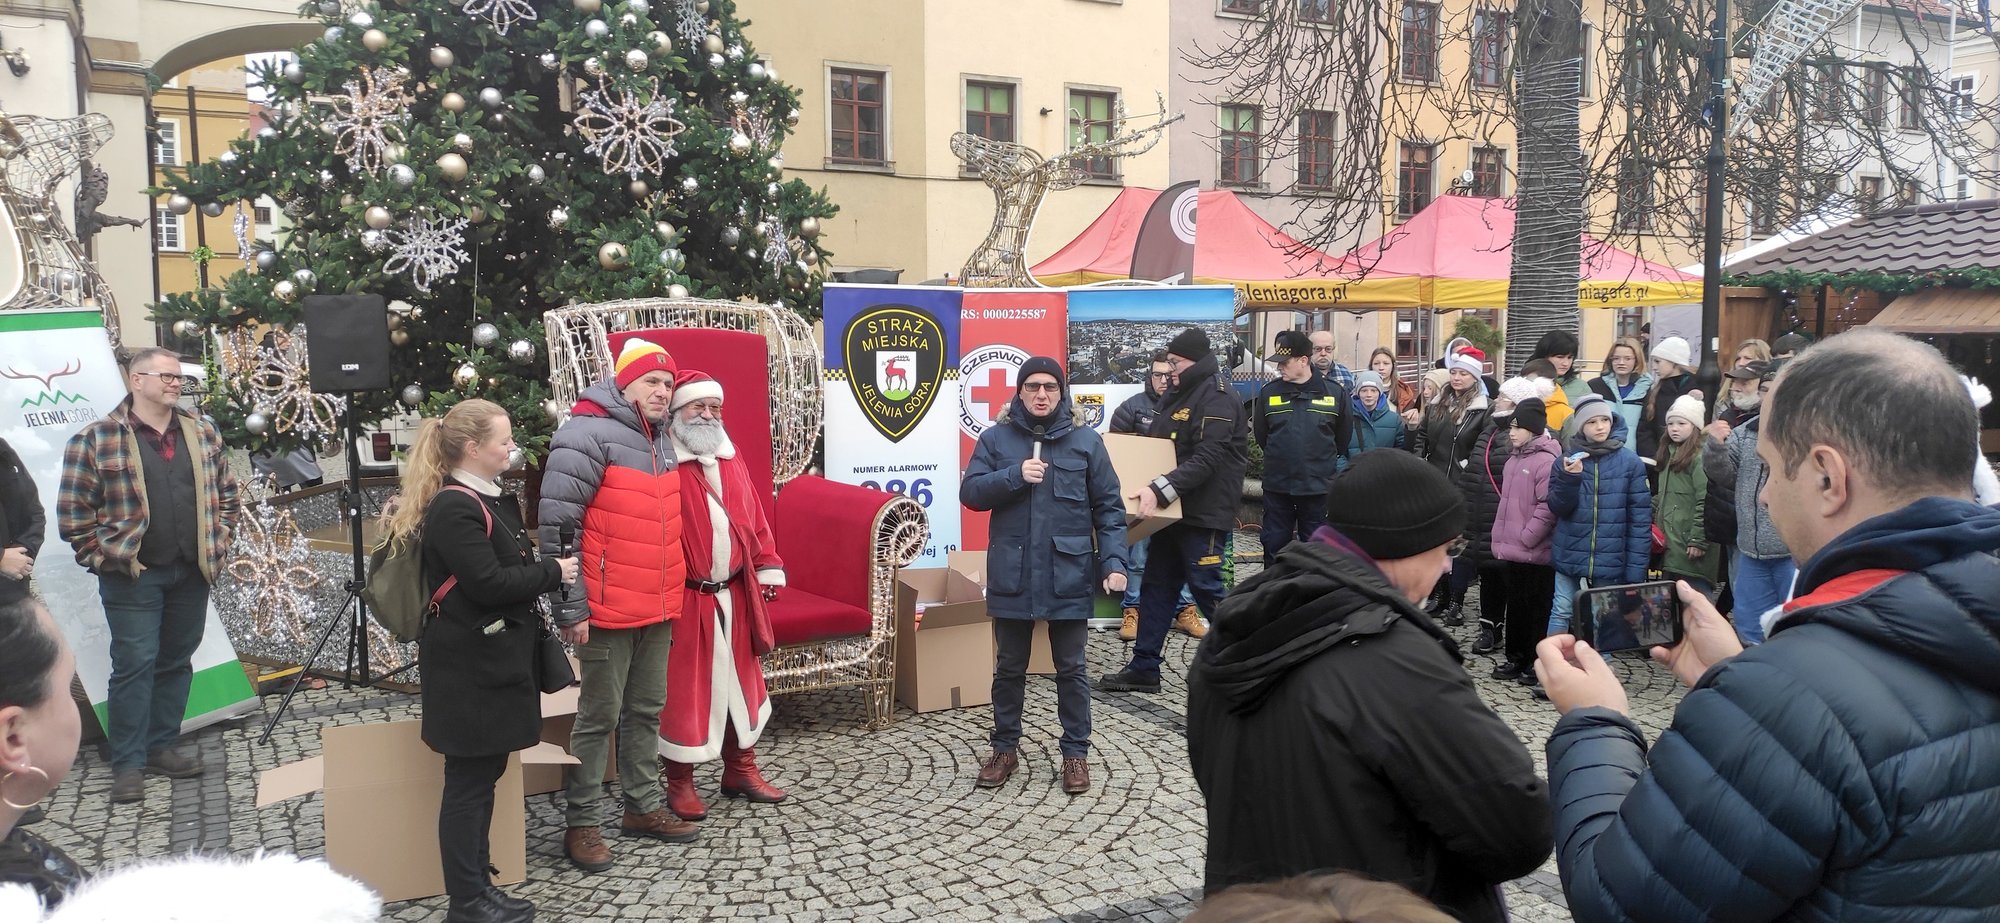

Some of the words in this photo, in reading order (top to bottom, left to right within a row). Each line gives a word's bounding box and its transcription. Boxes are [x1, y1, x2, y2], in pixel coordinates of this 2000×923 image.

[983, 308, 1047, 320] 0000225587
[867, 318, 924, 334] STRAŻ
[862, 335, 929, 352] MIEJSKA
[861, 383, 903, 418] JELENIA
[904, 381, 932, 414] GÓRA
[24, 410, 69, 428] JELENIA
[67, 407, 99, 424] GÓRA
[853, 465, 885, 474] NUMER
[887, 463, 938, 473] ALARMOWY
